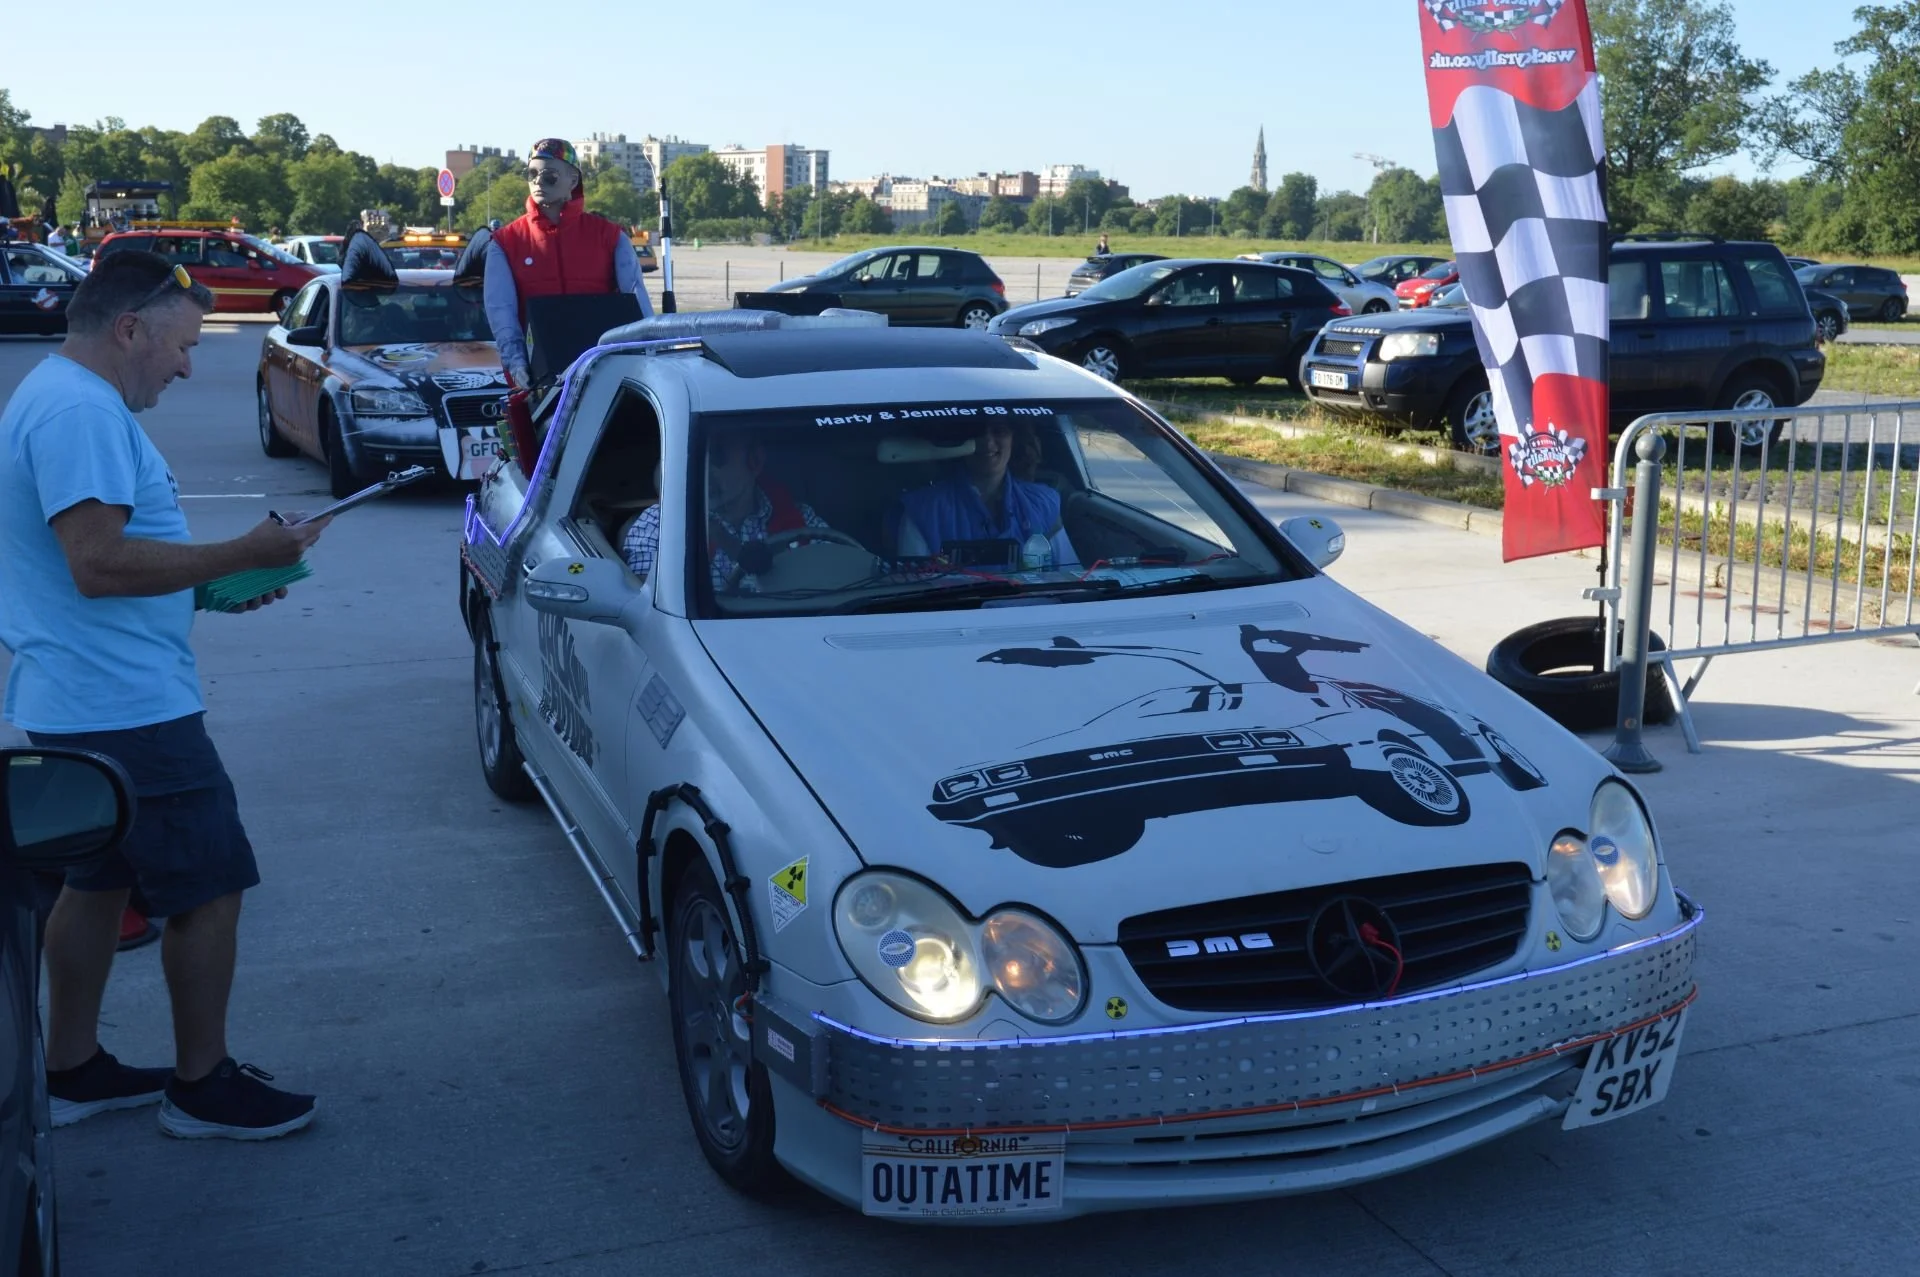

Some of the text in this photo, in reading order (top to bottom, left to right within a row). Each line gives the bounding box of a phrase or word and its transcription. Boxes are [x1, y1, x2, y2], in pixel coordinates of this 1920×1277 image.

[815, 406, 1054, 427] Marty & Jennifer 88 mph
[1594, 1010, 1682, 1074] KV52
[1590, 1058, 1662, 1117] SBX
[908, 1137, 1019, 1154] CALIFORNIA
[873, 1161, 1052, 1204] OUTATIME
